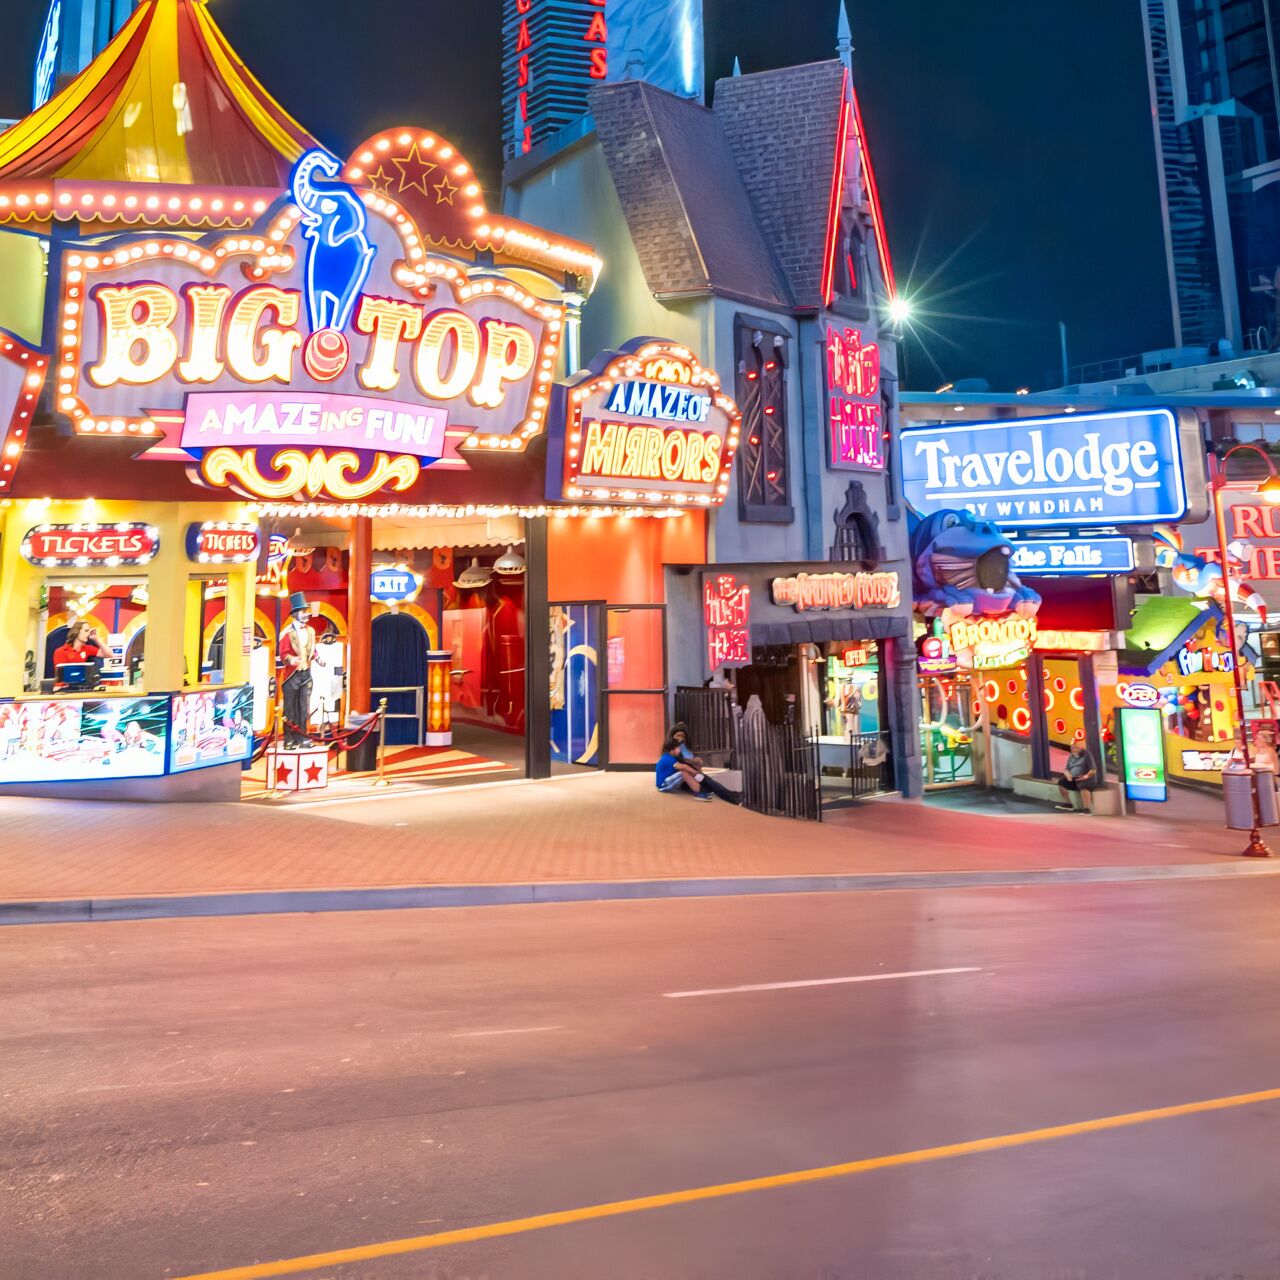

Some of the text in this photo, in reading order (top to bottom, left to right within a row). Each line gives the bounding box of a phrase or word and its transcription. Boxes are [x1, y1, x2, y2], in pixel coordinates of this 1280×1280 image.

[88, 280, 539, 410] BIG TOP
[609, 380, 712, 423] A MAZE OF
[365, 407, 437, 447] FUN!
[581, 422, 722, 483] MIRRORS
[916, 430, 1160, 497] Travelodge
[965, 497, 1104, 517] BY WYNDHAM
[39, 534, 144, 554] TICKETS
[205, 533, 256, 552] TICKETS
[1048, 545, 1104, 566] Falls
[373, 575, 409, 593] EXIT
[950, 617, 1037, 651] BRONTO'S
